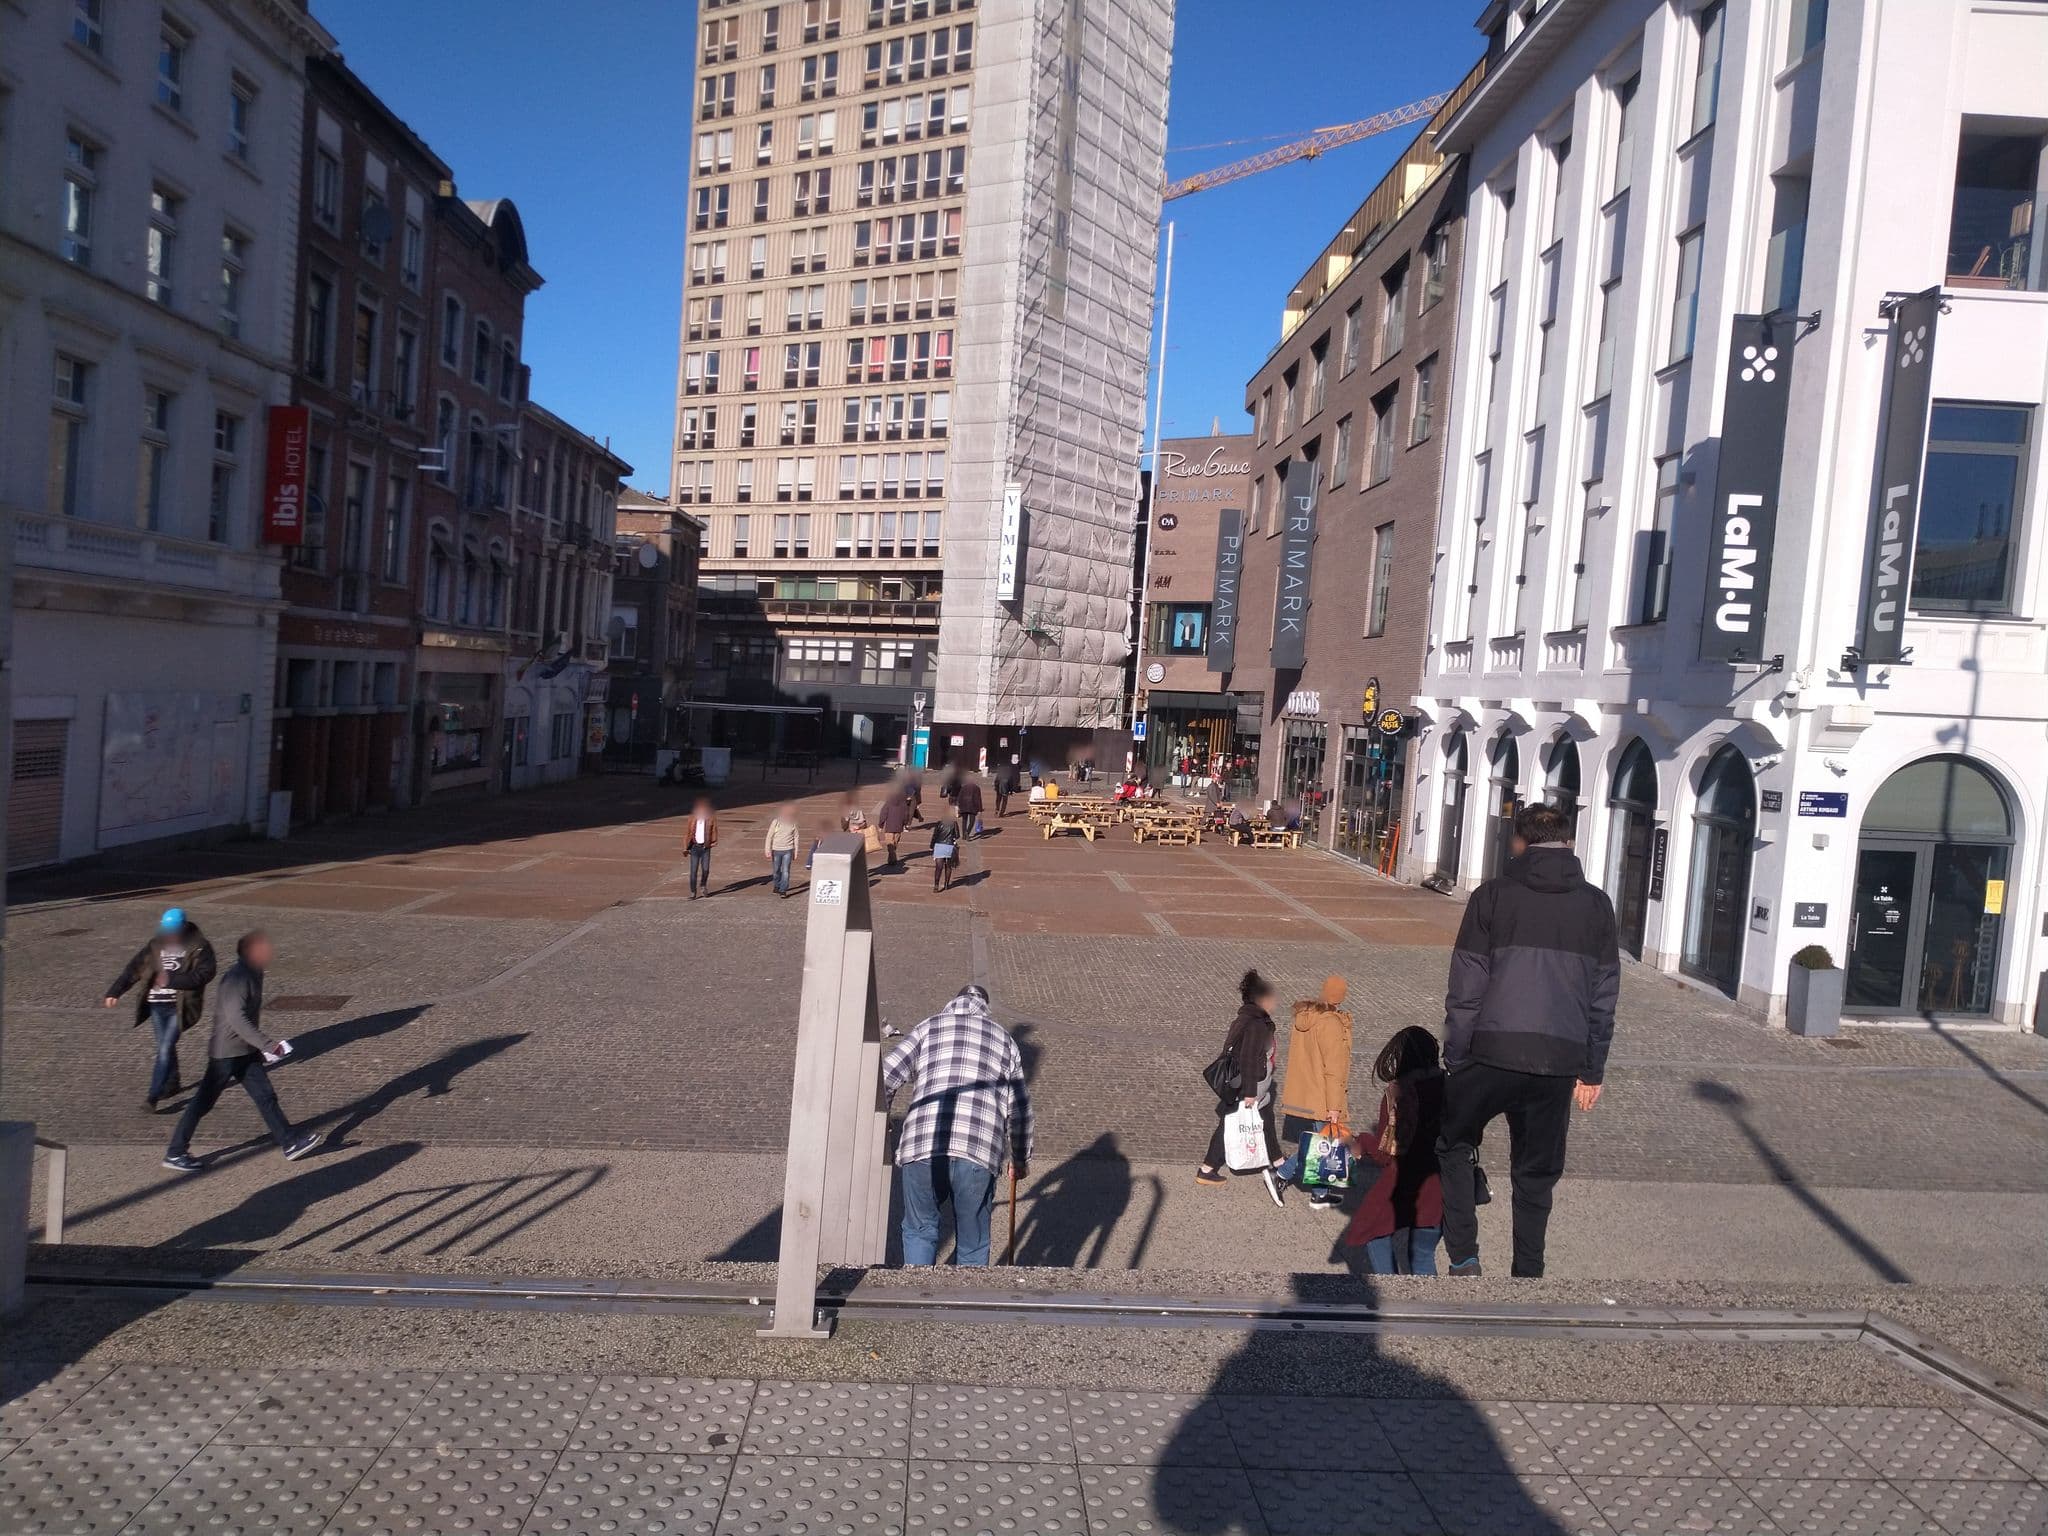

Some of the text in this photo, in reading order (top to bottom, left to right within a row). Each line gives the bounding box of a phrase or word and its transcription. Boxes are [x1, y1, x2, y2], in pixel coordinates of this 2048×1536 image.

[272, 427, 302, 526] ibis HOTEL
[1158, 488, 1235, 502] PRIMARK
[1002, 495, 1018, 584] VIMAR
[1215, 536, 1239, 644] PRIMARK
[1280, 496, 1312, 633] PRIMARK
[1715, 493, 1763, 633] LaM.U
[1872, 484, 1909, 632] LaM.U
